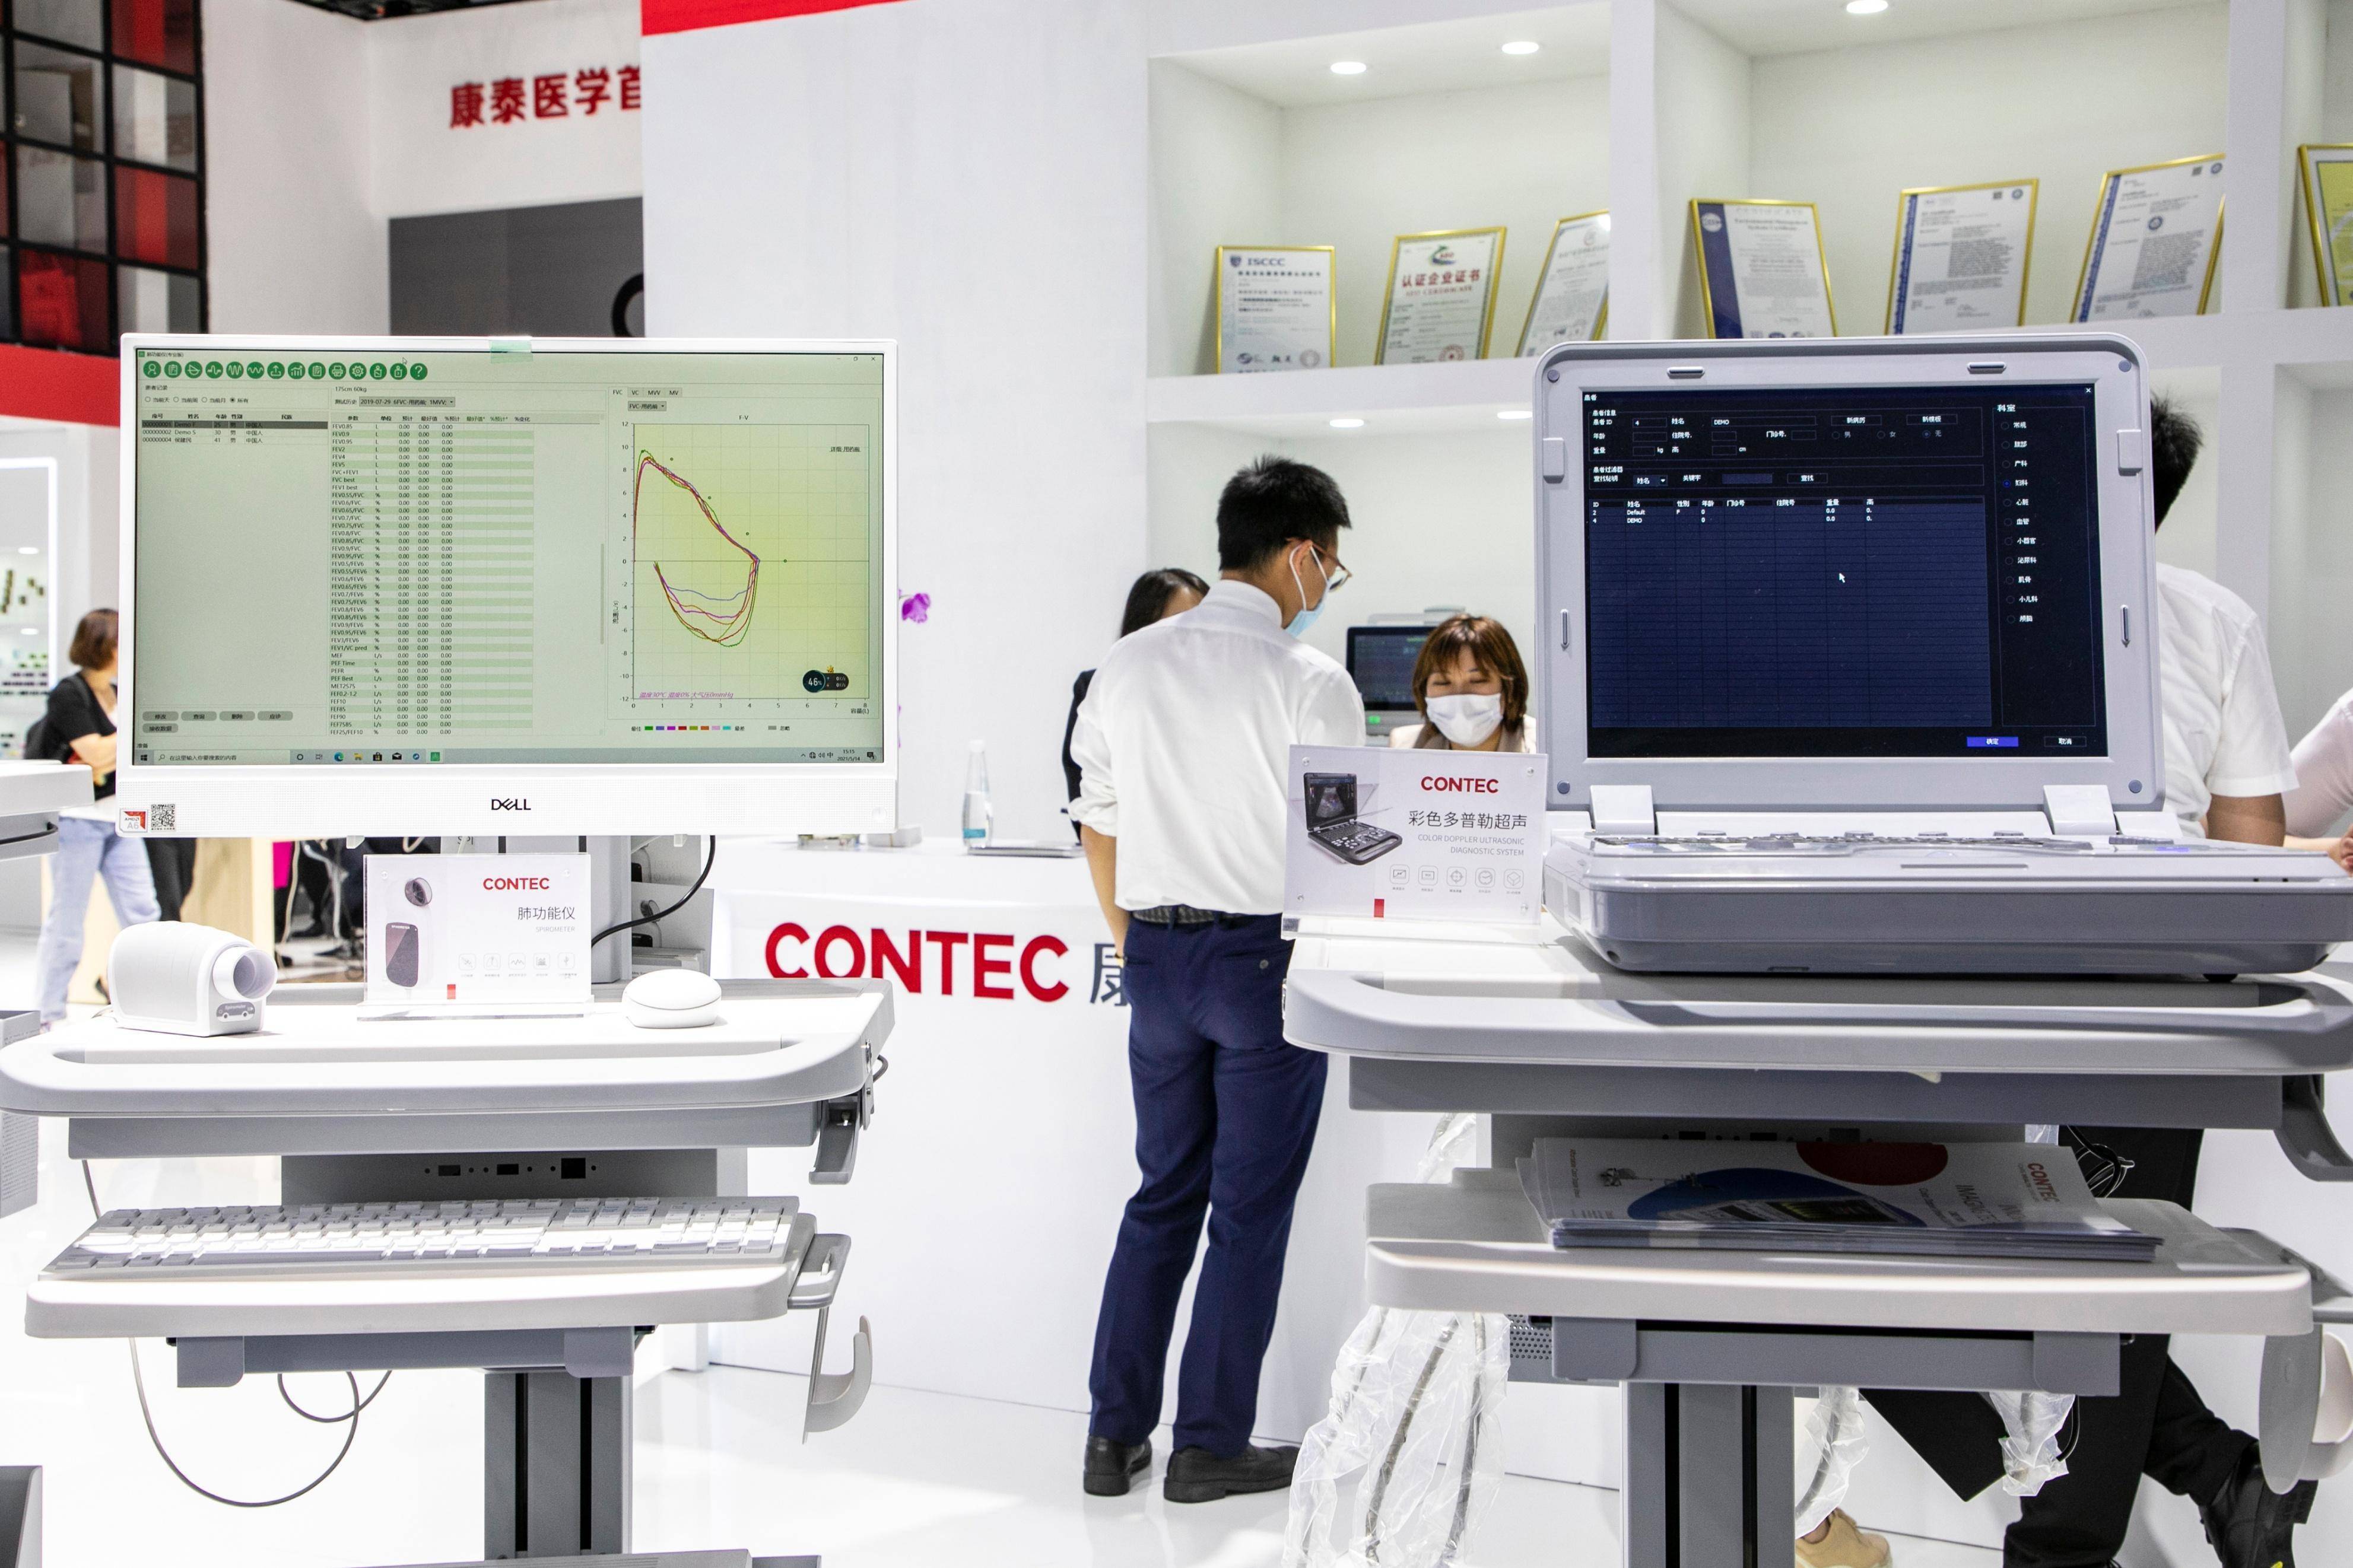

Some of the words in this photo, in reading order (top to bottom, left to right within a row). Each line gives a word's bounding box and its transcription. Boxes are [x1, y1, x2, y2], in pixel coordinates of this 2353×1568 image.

[1247, 256, 1285, 267] ISCCC
[1401, 268, 1480, 289] 认证企业证书
[1997, 404, 2015, 412] 科室
[1421, 776, 1499, 793] CONTEC
[491, 799, 531, 810] DELL
[1408, 810, 1527, 830] 彩色多普勒超声
[1444, 835, 1478, 843] DOPPLER
[1480, 837, 1525, 845] ULTRASONIC
[1450, 847, 1495, 855] DIAGNOSTIC
[483, 878, 550, 890] CONTEC
[517, 907, 575, 920] 肺功能仪
[765, 923, 1069, 1002] CONTEC
